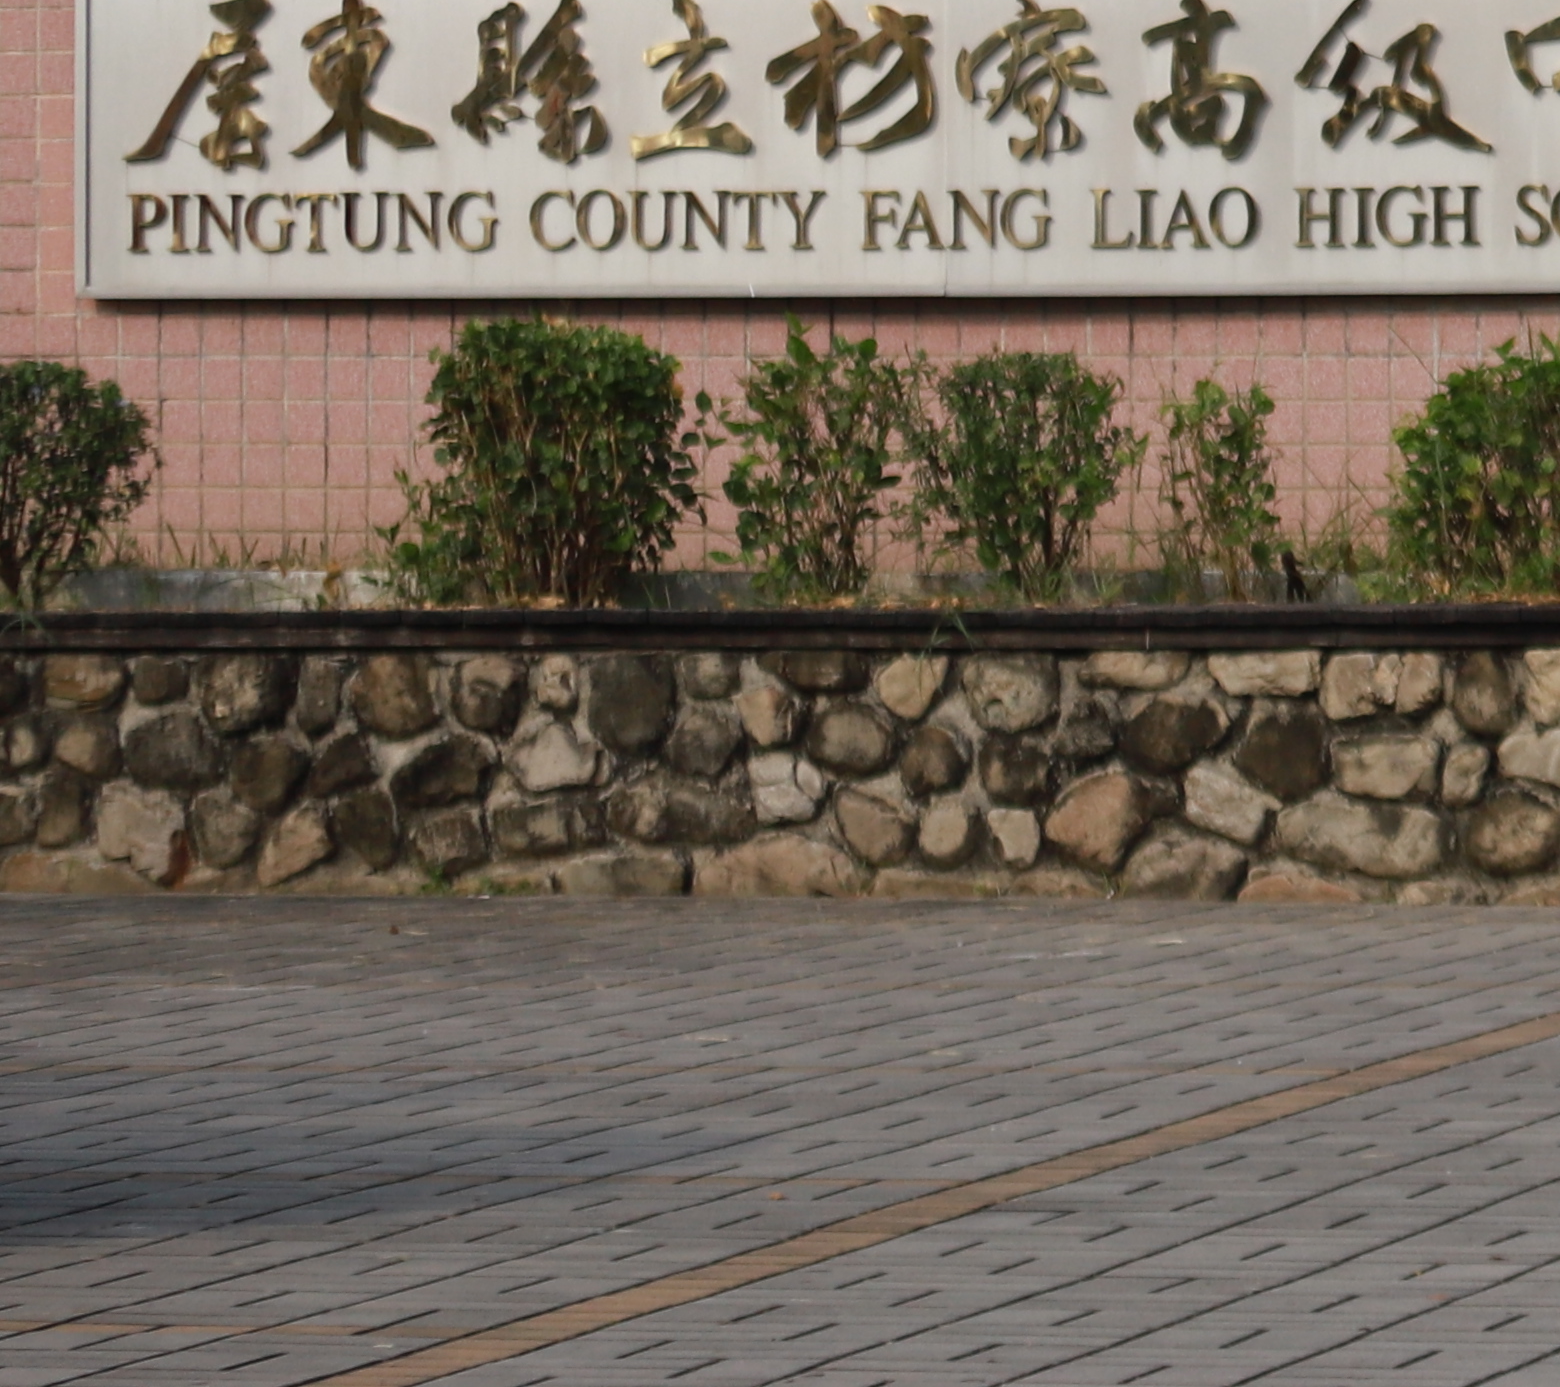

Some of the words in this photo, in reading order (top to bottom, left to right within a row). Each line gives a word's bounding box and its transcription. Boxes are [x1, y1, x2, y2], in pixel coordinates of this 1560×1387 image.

[127, 190, 499, 256] PINGTUNG
[529, 188, 827, 254] COUNTY
[860, 187, 1053, 253] FANG
[1091, 186, 1262, 252] LIAO
[1295, 184, 1481, 251] HIGH
